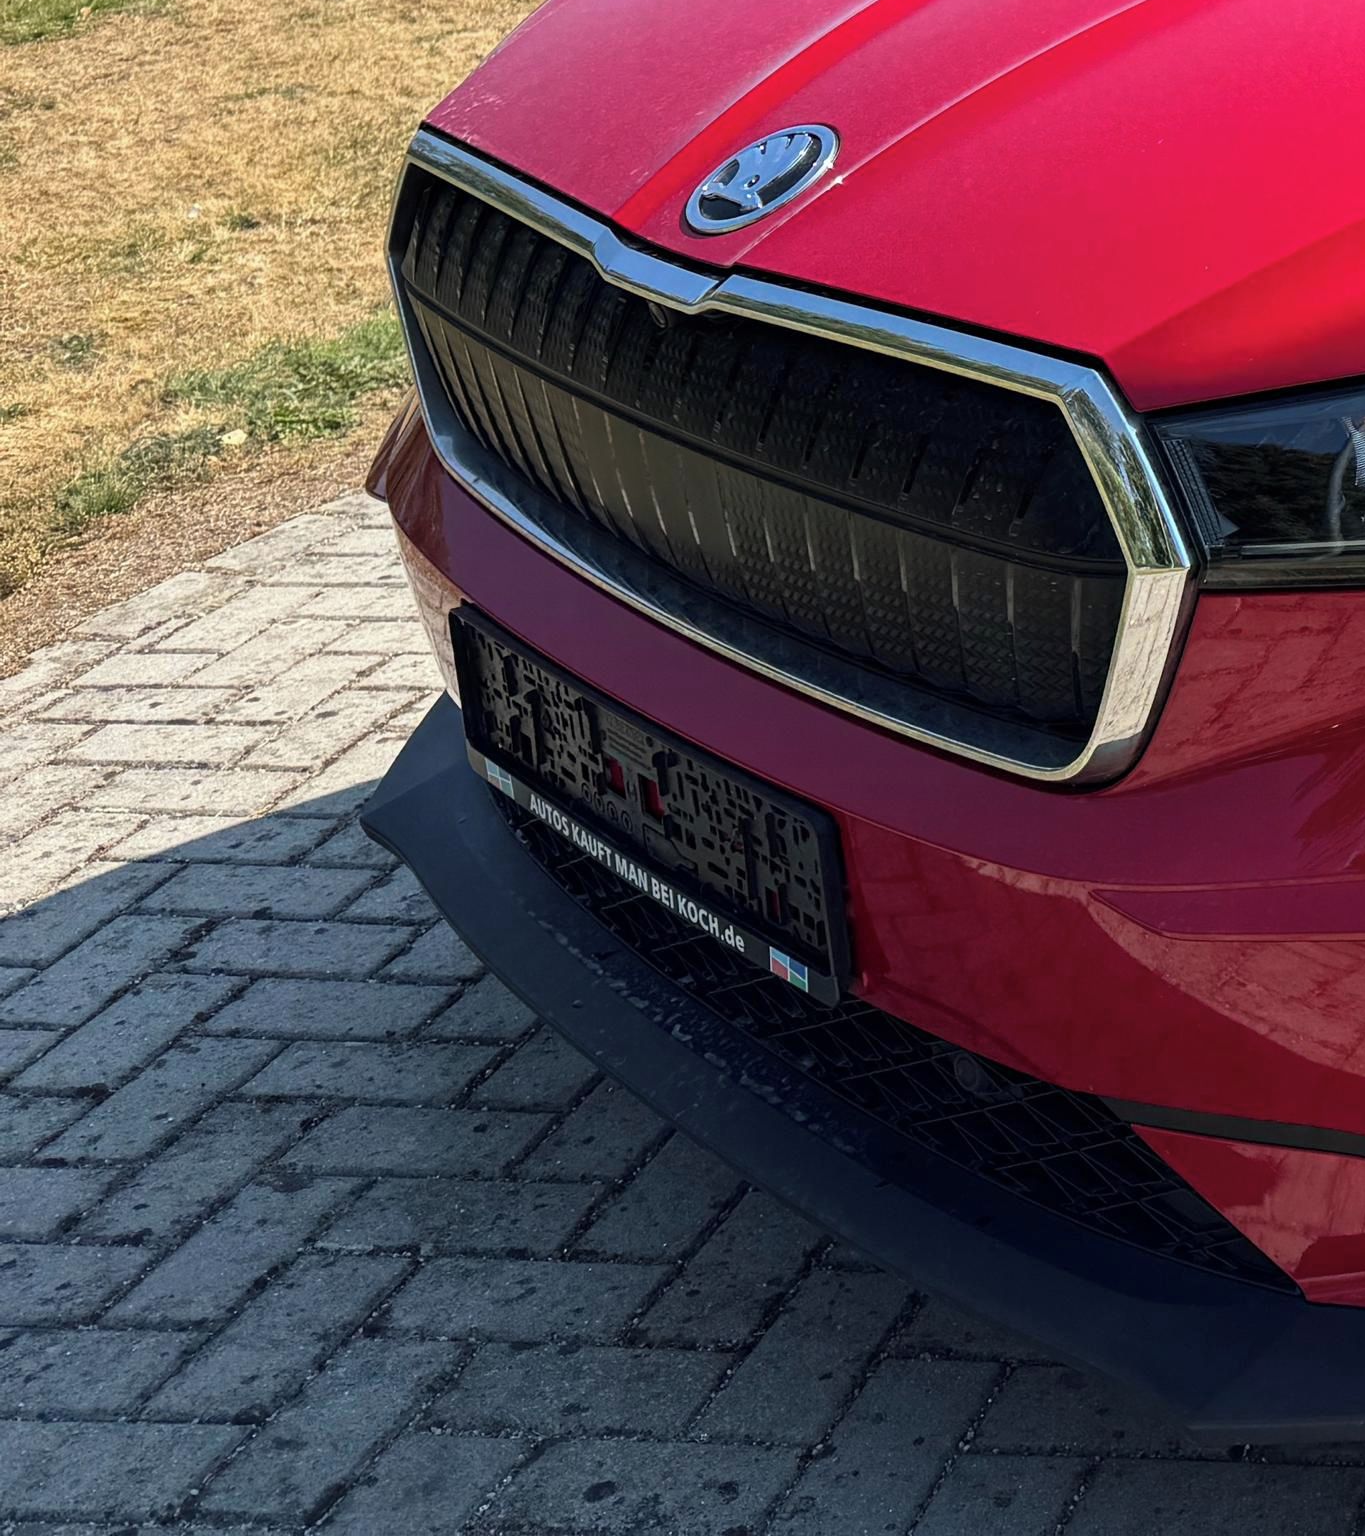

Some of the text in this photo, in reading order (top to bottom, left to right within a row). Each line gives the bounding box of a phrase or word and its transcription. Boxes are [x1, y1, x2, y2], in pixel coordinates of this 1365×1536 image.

[530, 793, 745, 953] AUTOS KAUFT MAN BEI KOCH.de
